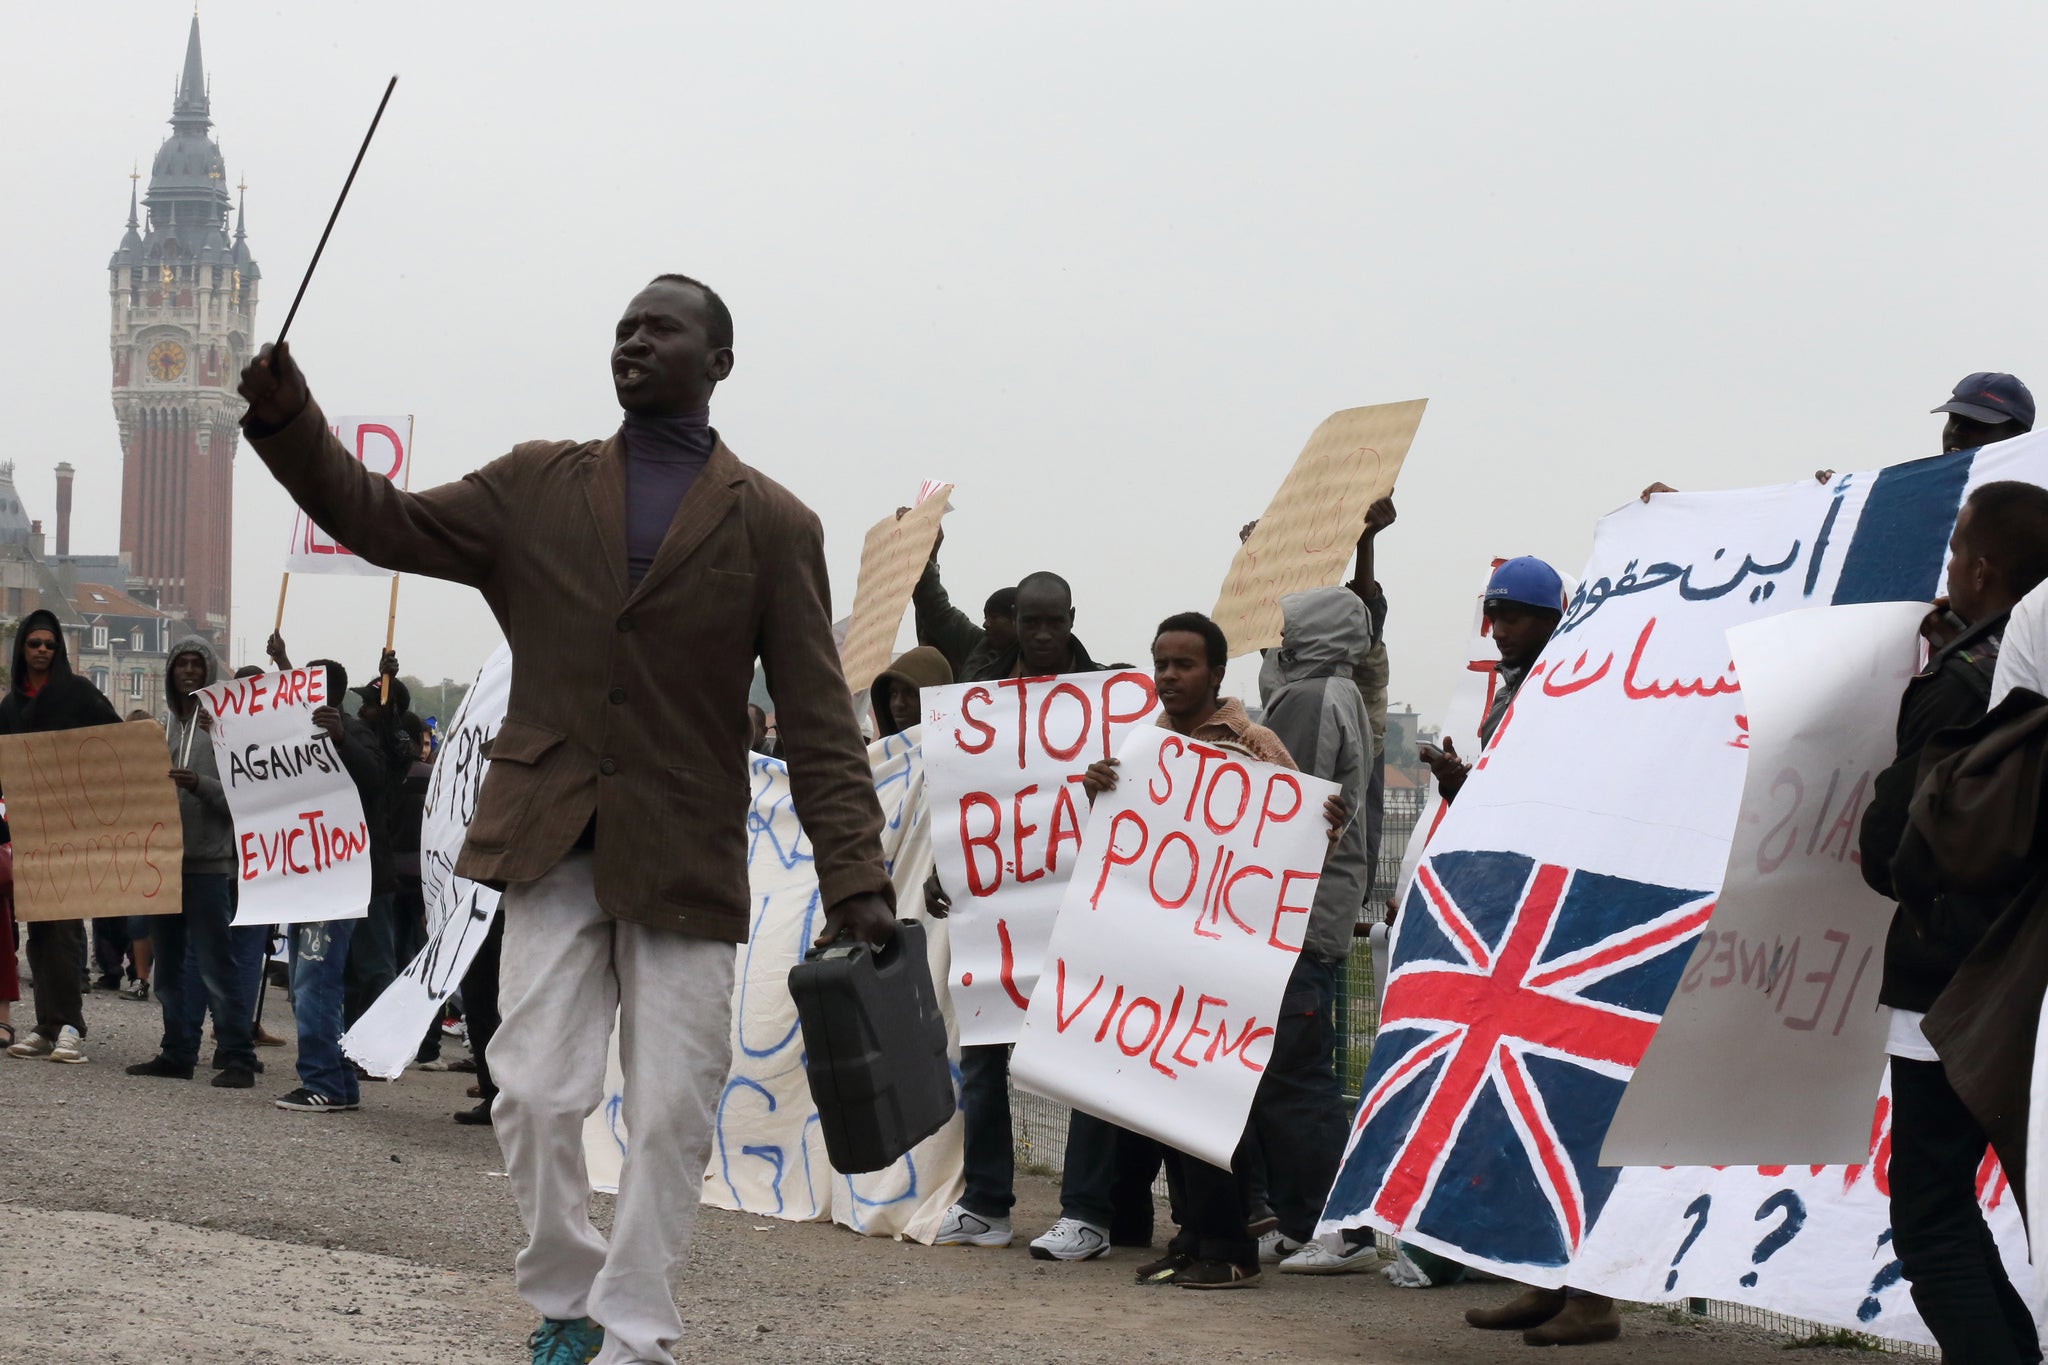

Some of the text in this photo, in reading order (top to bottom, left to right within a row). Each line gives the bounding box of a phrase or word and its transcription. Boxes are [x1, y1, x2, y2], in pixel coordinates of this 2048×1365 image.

[202, 666, 325, 718] WE ARE
[954, 671, 1158, 769] STOP
[24, 736, 126, 845] NO
[230, 732, 341, 788] AGAINST
[1149, 736, 1302, 847] STOP
[241, 810, 367, 881] EVICTION
[1090, 810, 1321, 953] POLICE
